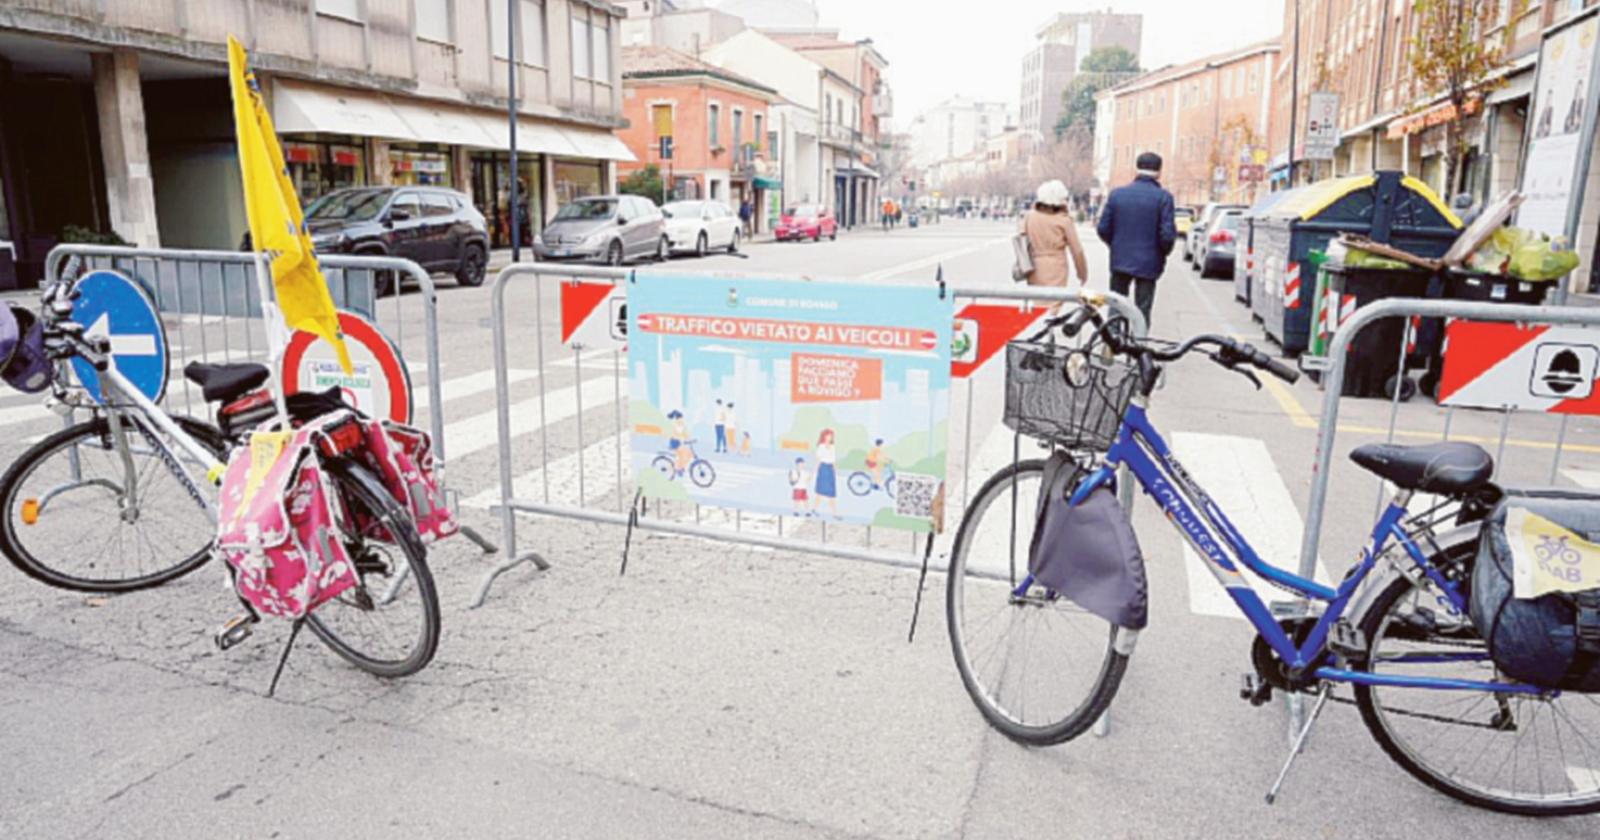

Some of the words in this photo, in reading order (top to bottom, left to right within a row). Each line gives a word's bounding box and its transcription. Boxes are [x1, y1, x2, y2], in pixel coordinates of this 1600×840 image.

[746, 297, 785, 306] COMUNE
[801, 299, 838, 309] ROVIGO
[657, 316, 737, 335] TRAFFICO
[739, 321, 811, 341] VIETATO
[815, 326, 833, 341] AI
[837, 327, 911, 347] VEICOLI
[798, 357, 858, 369] DOMENICA
[798, 366, 856, 378] FACCIAMO
[798, 375, 817, 385] DUE
[823, 377, 853, 387] PASSI
[808, 386, 851, 397] ROVIGO
